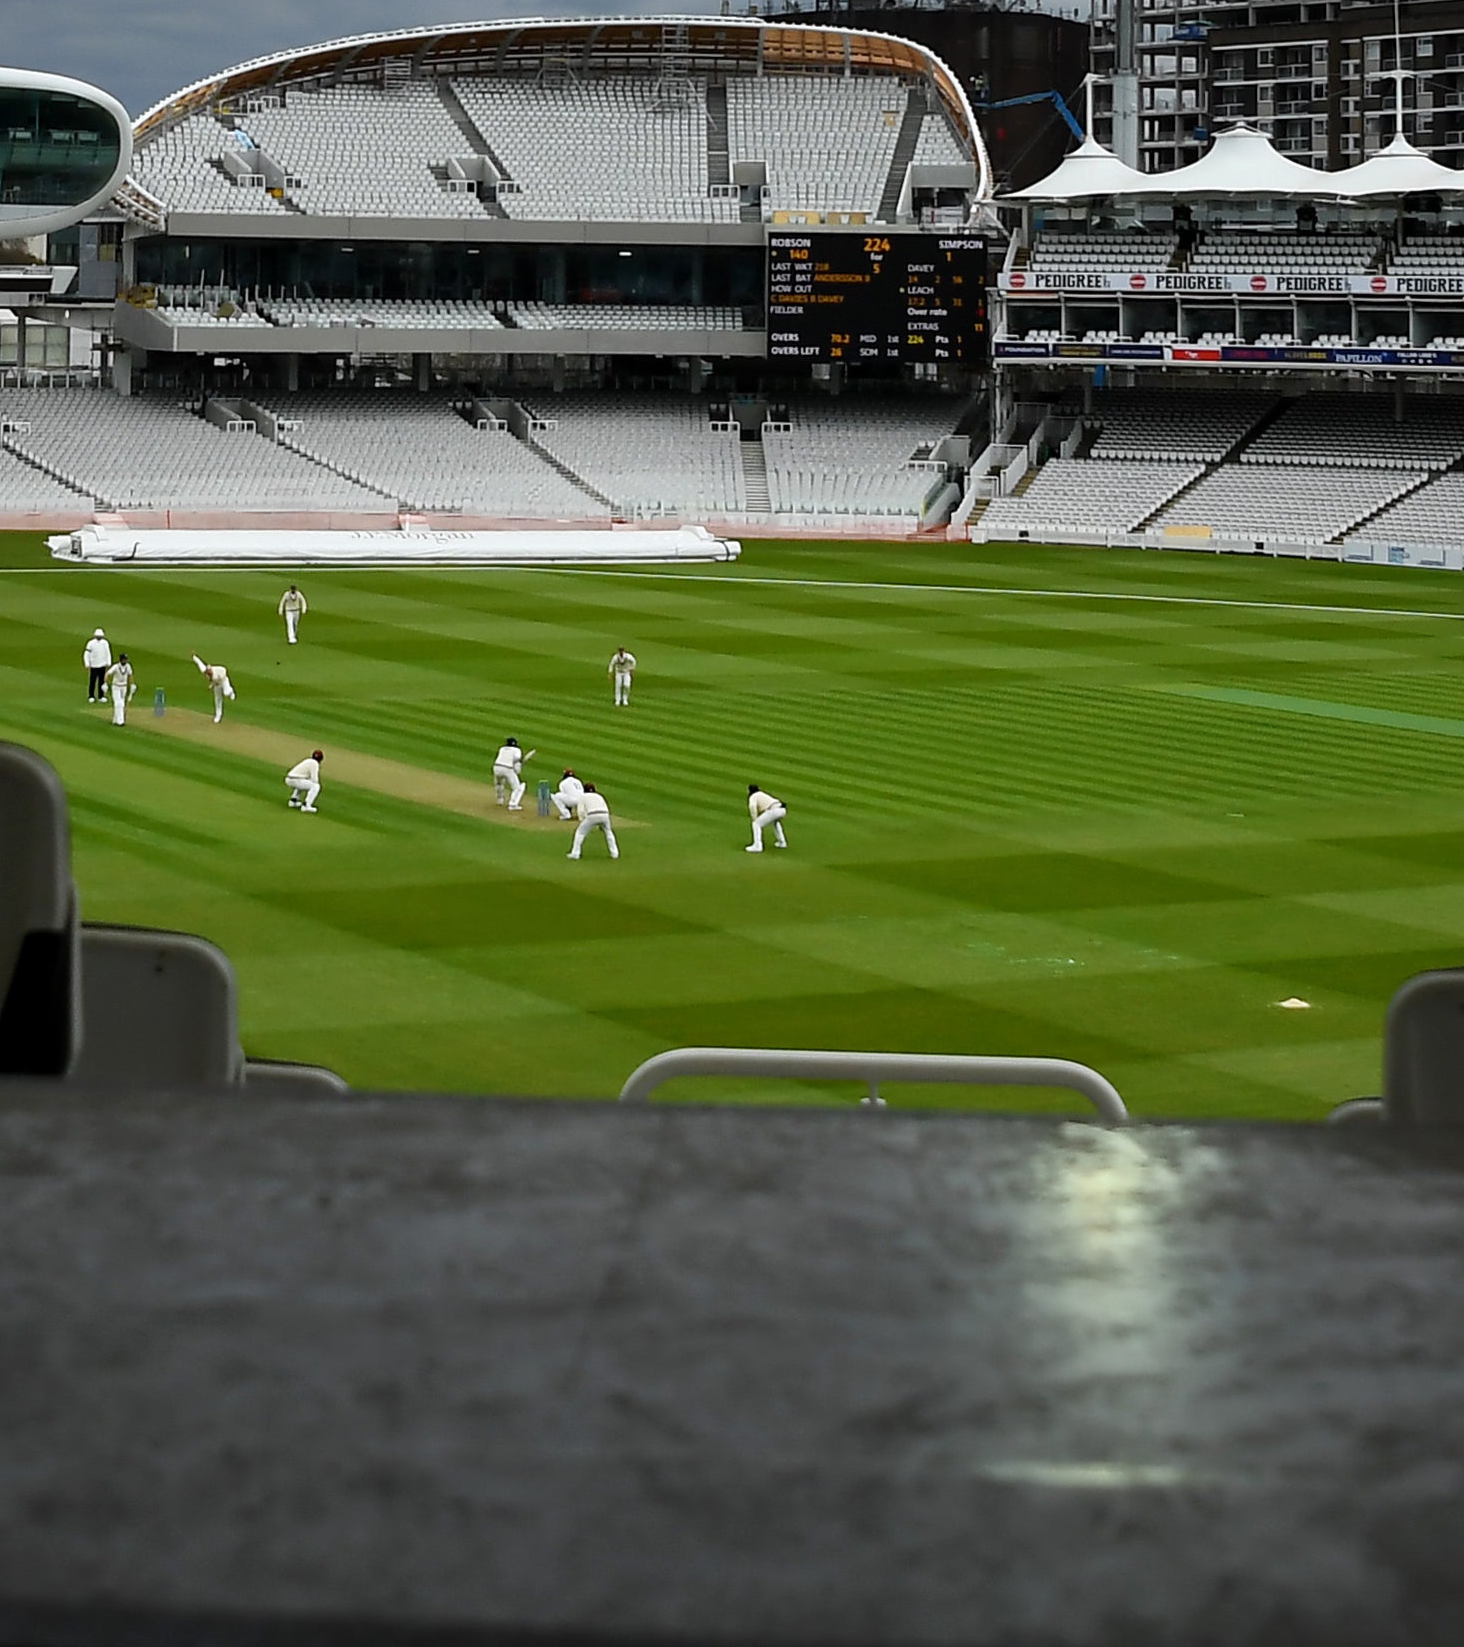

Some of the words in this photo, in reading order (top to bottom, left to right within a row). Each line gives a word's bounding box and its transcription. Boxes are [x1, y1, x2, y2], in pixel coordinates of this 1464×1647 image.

[771, 238, 811, 248] ROBSON
[863, 238, 891, 252] 224
[938, 240, 984, 250] SIMPSON
[789, 249, 810, 259] 140
[870, 252, 884, 261] for
[946, 252, 952, 262] 1
[771, 263, 792, 271] LAST
[873, 263, 881, 273] 5
[907, 264, 935, 273] DAVEY
[771, 274, 792, 282] LAST
[795, 274, 812, 282] BAT
[1035, 274, 1102, 288] PEDIGREE
[1155, 275, 1223, 290] PEDIGREE
[1276, 276, 1343, 291] PEDIGREE
[1396, 278, 1463, 292] PEDIGREE
[771, 285, 793, 293] HOW
[794, 285, 813, 293] OUT
[907, 286, 935, 295] LEACH
[770, 306, 804, 314] FIELDER
[907, 307, 928, 316] Over
[929, 308, 948, 316] rate
[907, 322, 939, 331] EXTRAS
[771, 333, 799, 342] OVERS
[935, 335, 949, 344] Pts
[771, 347, 799, 355] OVERS
[800, 347, 820, 355] LEFT
[859, 348, 879, 356] SOM
[935, 349, 949, 357] Pts
[1335, 354, 1382, 363] PAPILLON
